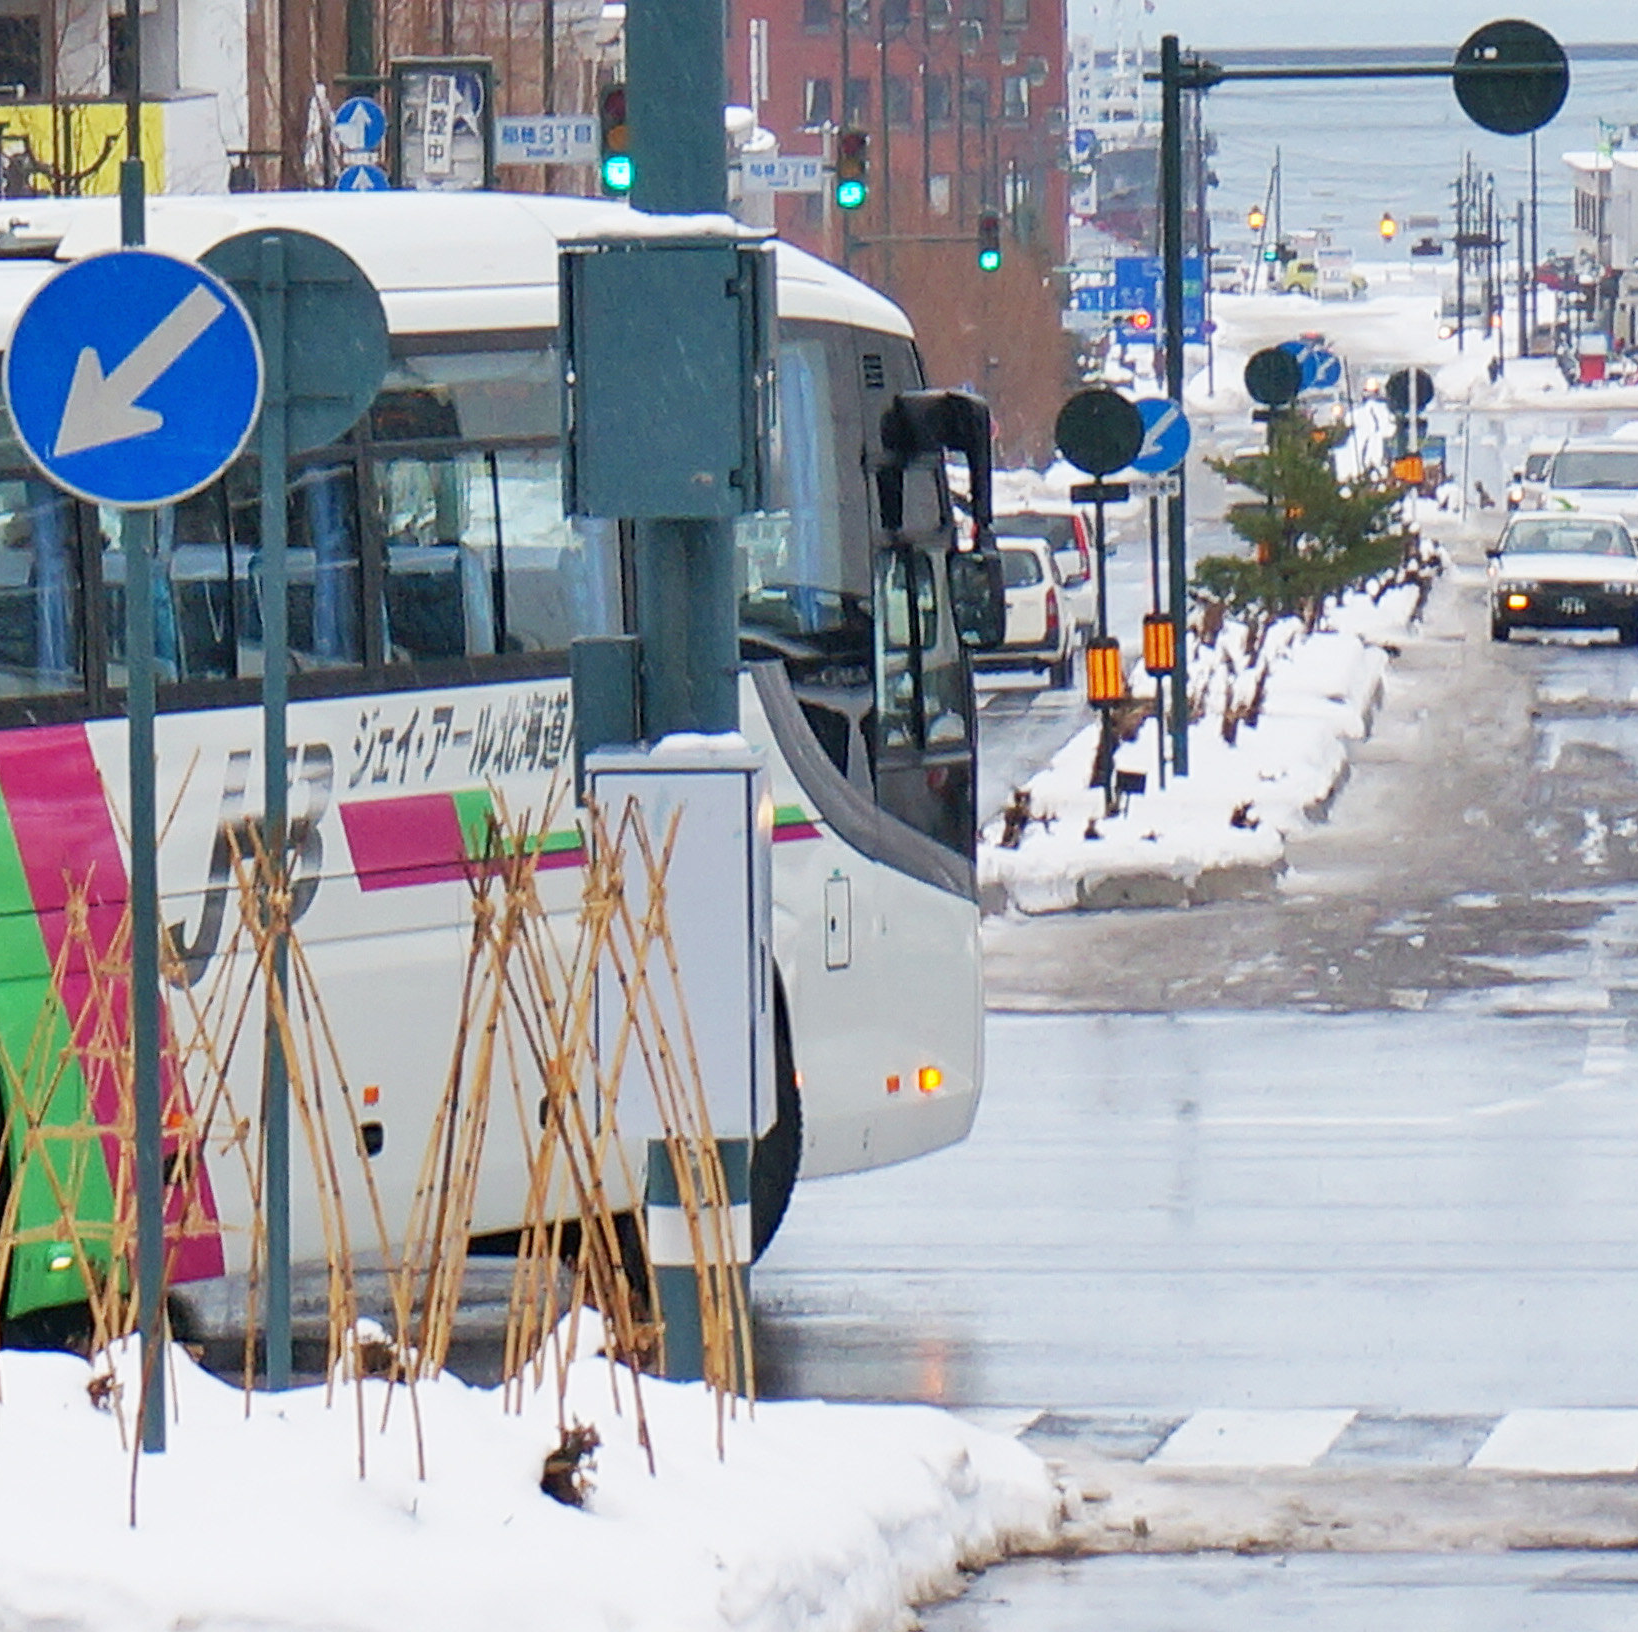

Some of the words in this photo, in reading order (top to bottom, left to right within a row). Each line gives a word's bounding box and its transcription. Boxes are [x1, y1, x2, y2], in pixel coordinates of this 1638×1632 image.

[348, 690, 574, 790] ジェイ・アール北海道
